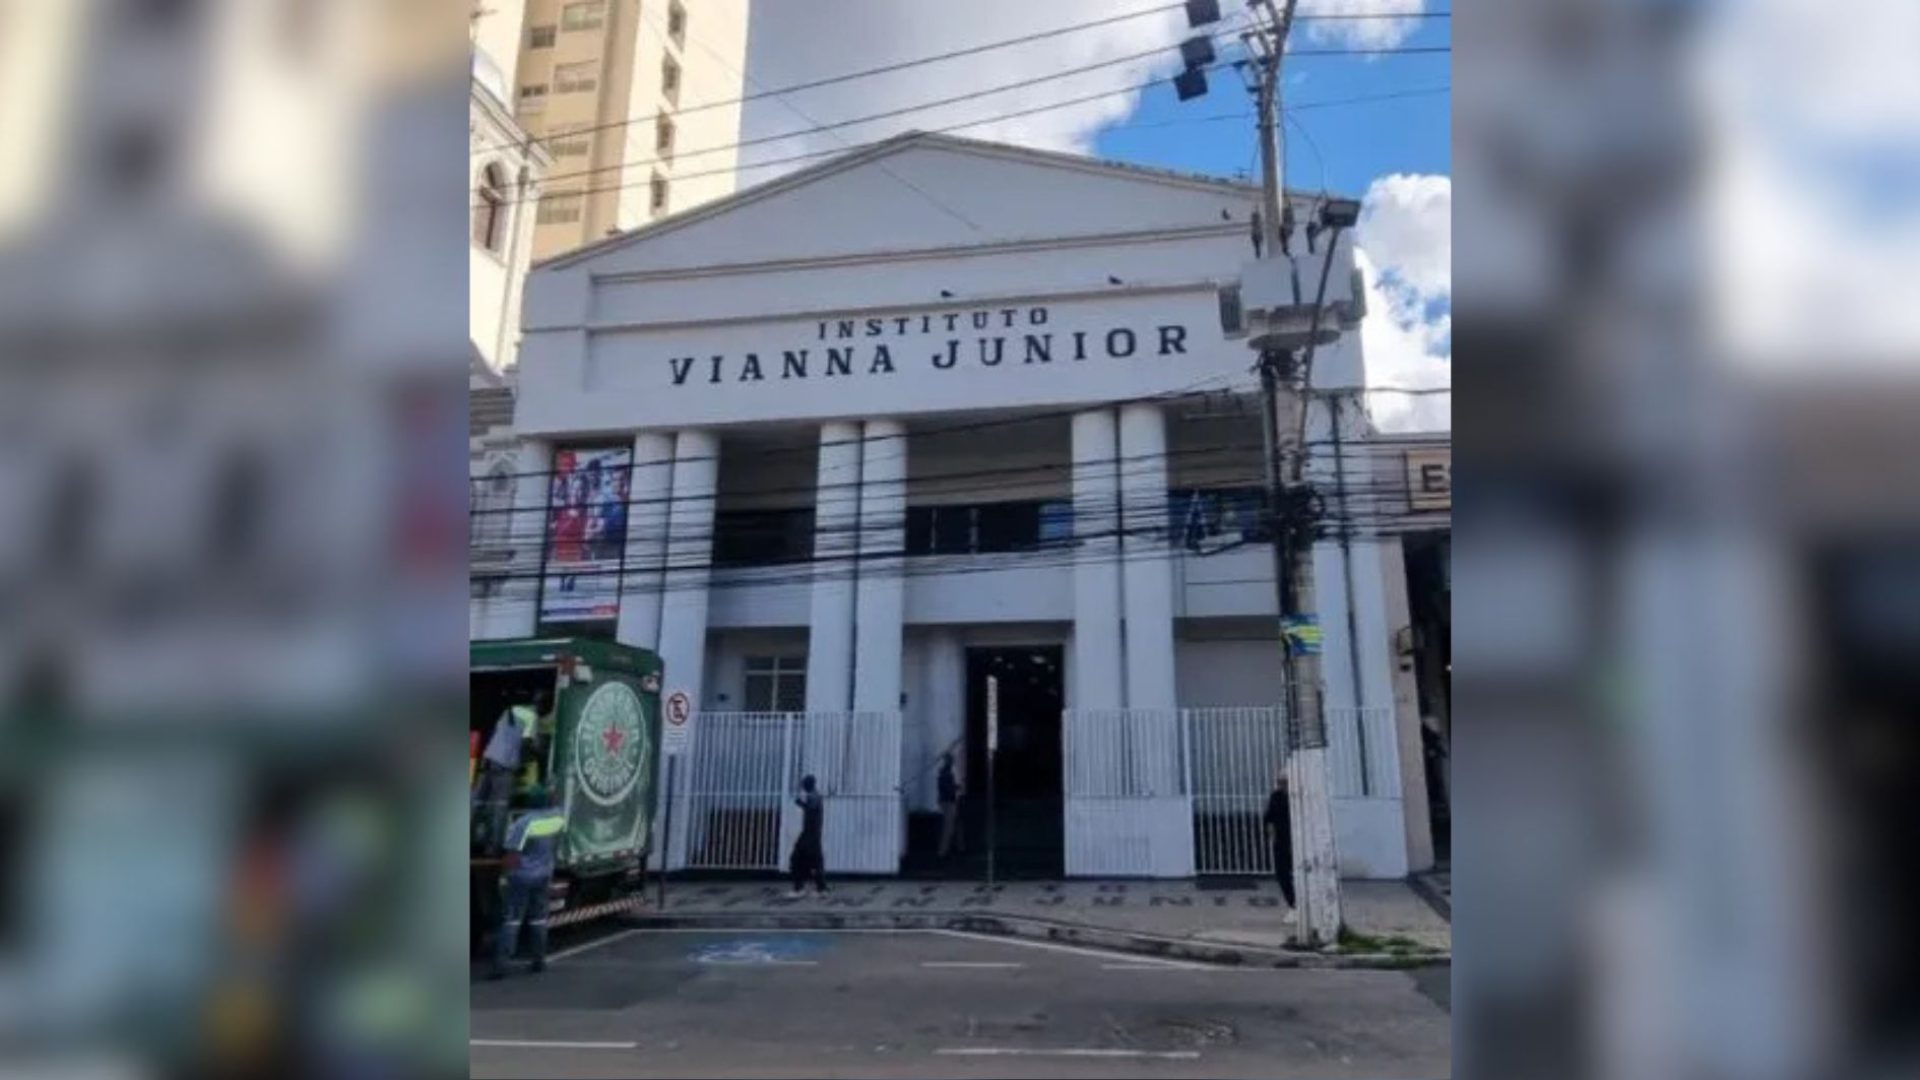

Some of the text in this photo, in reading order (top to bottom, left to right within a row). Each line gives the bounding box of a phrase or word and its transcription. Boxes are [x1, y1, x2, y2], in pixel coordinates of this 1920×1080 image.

[817, 307, 1050, 341] INSTITUTO
[669, 324, 1189, 385] VIANNA JUNIOR
[1422, 464, 1451, 493] E
